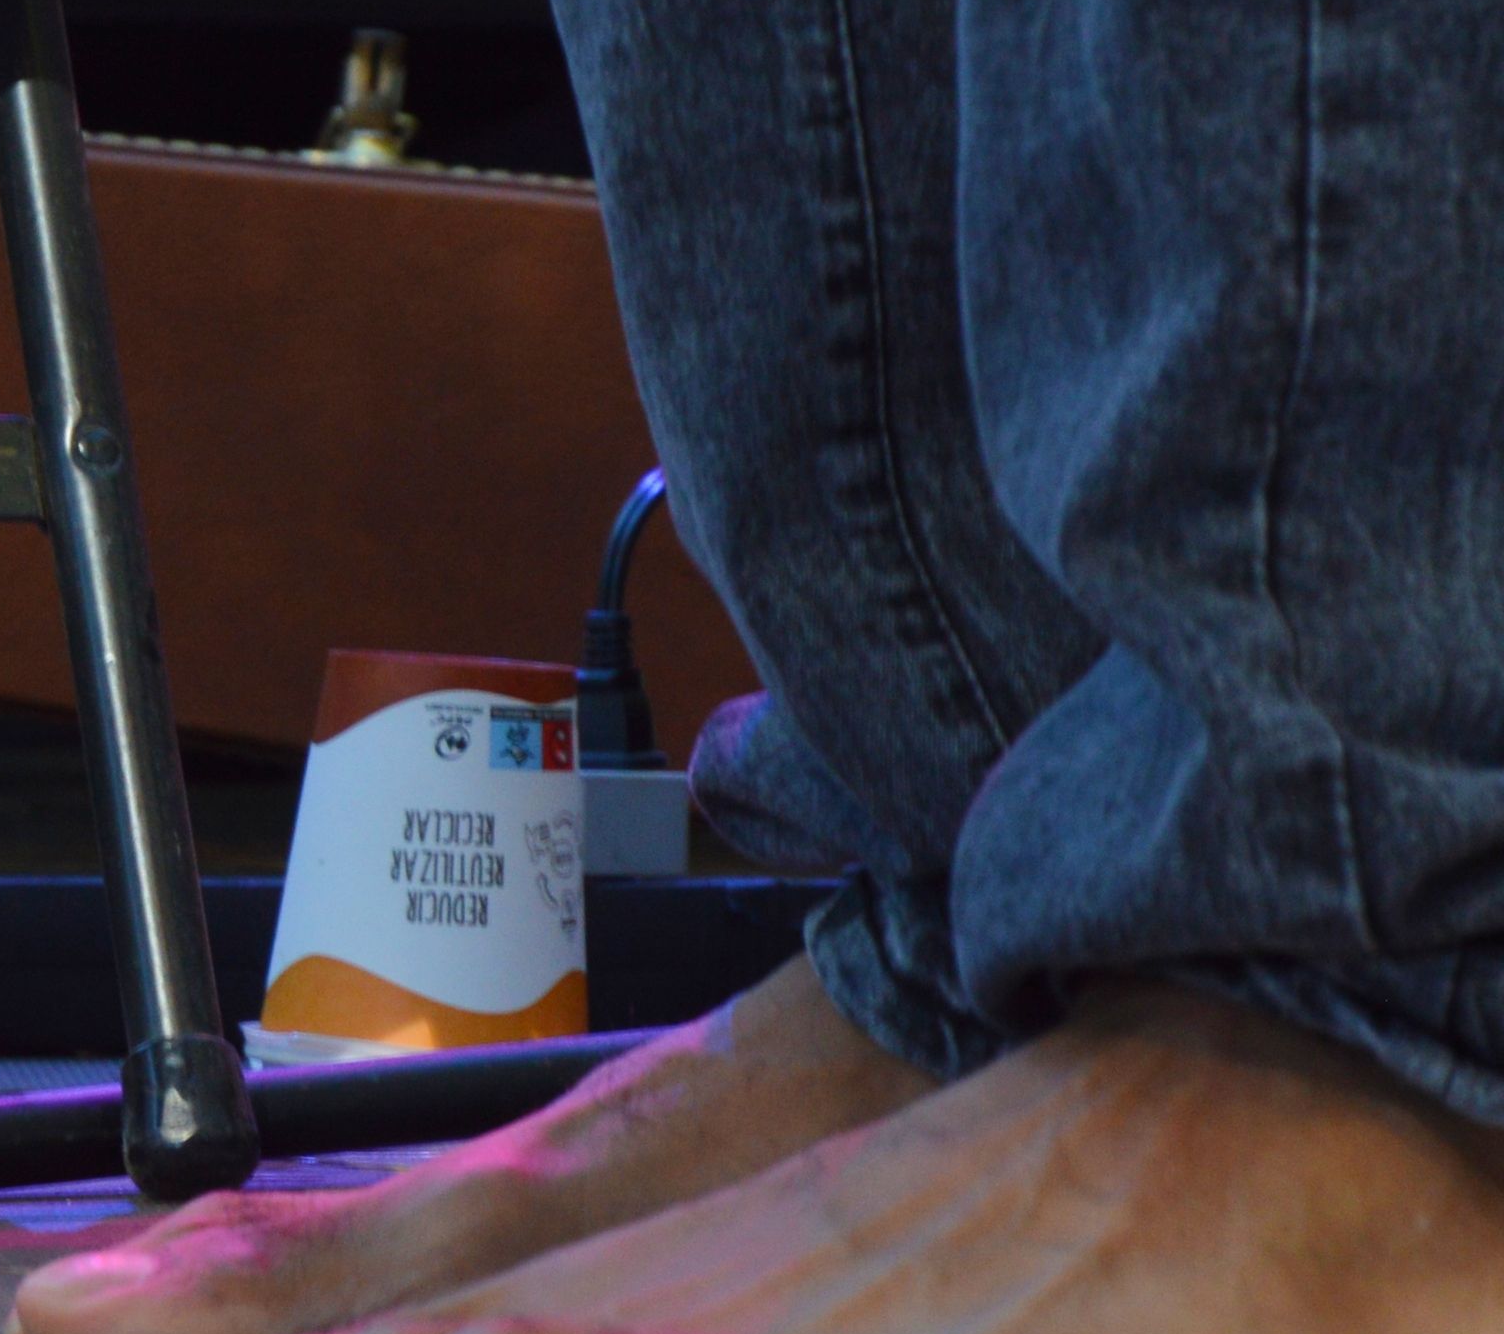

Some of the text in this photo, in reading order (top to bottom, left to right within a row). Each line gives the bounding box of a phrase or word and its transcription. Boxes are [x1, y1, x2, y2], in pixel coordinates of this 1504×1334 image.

[404, 809, 495, 847] RECICLAR
[392, 849, 505, 889] REUTILIZAR
[407, 891, 488, 927] REDUCIR
